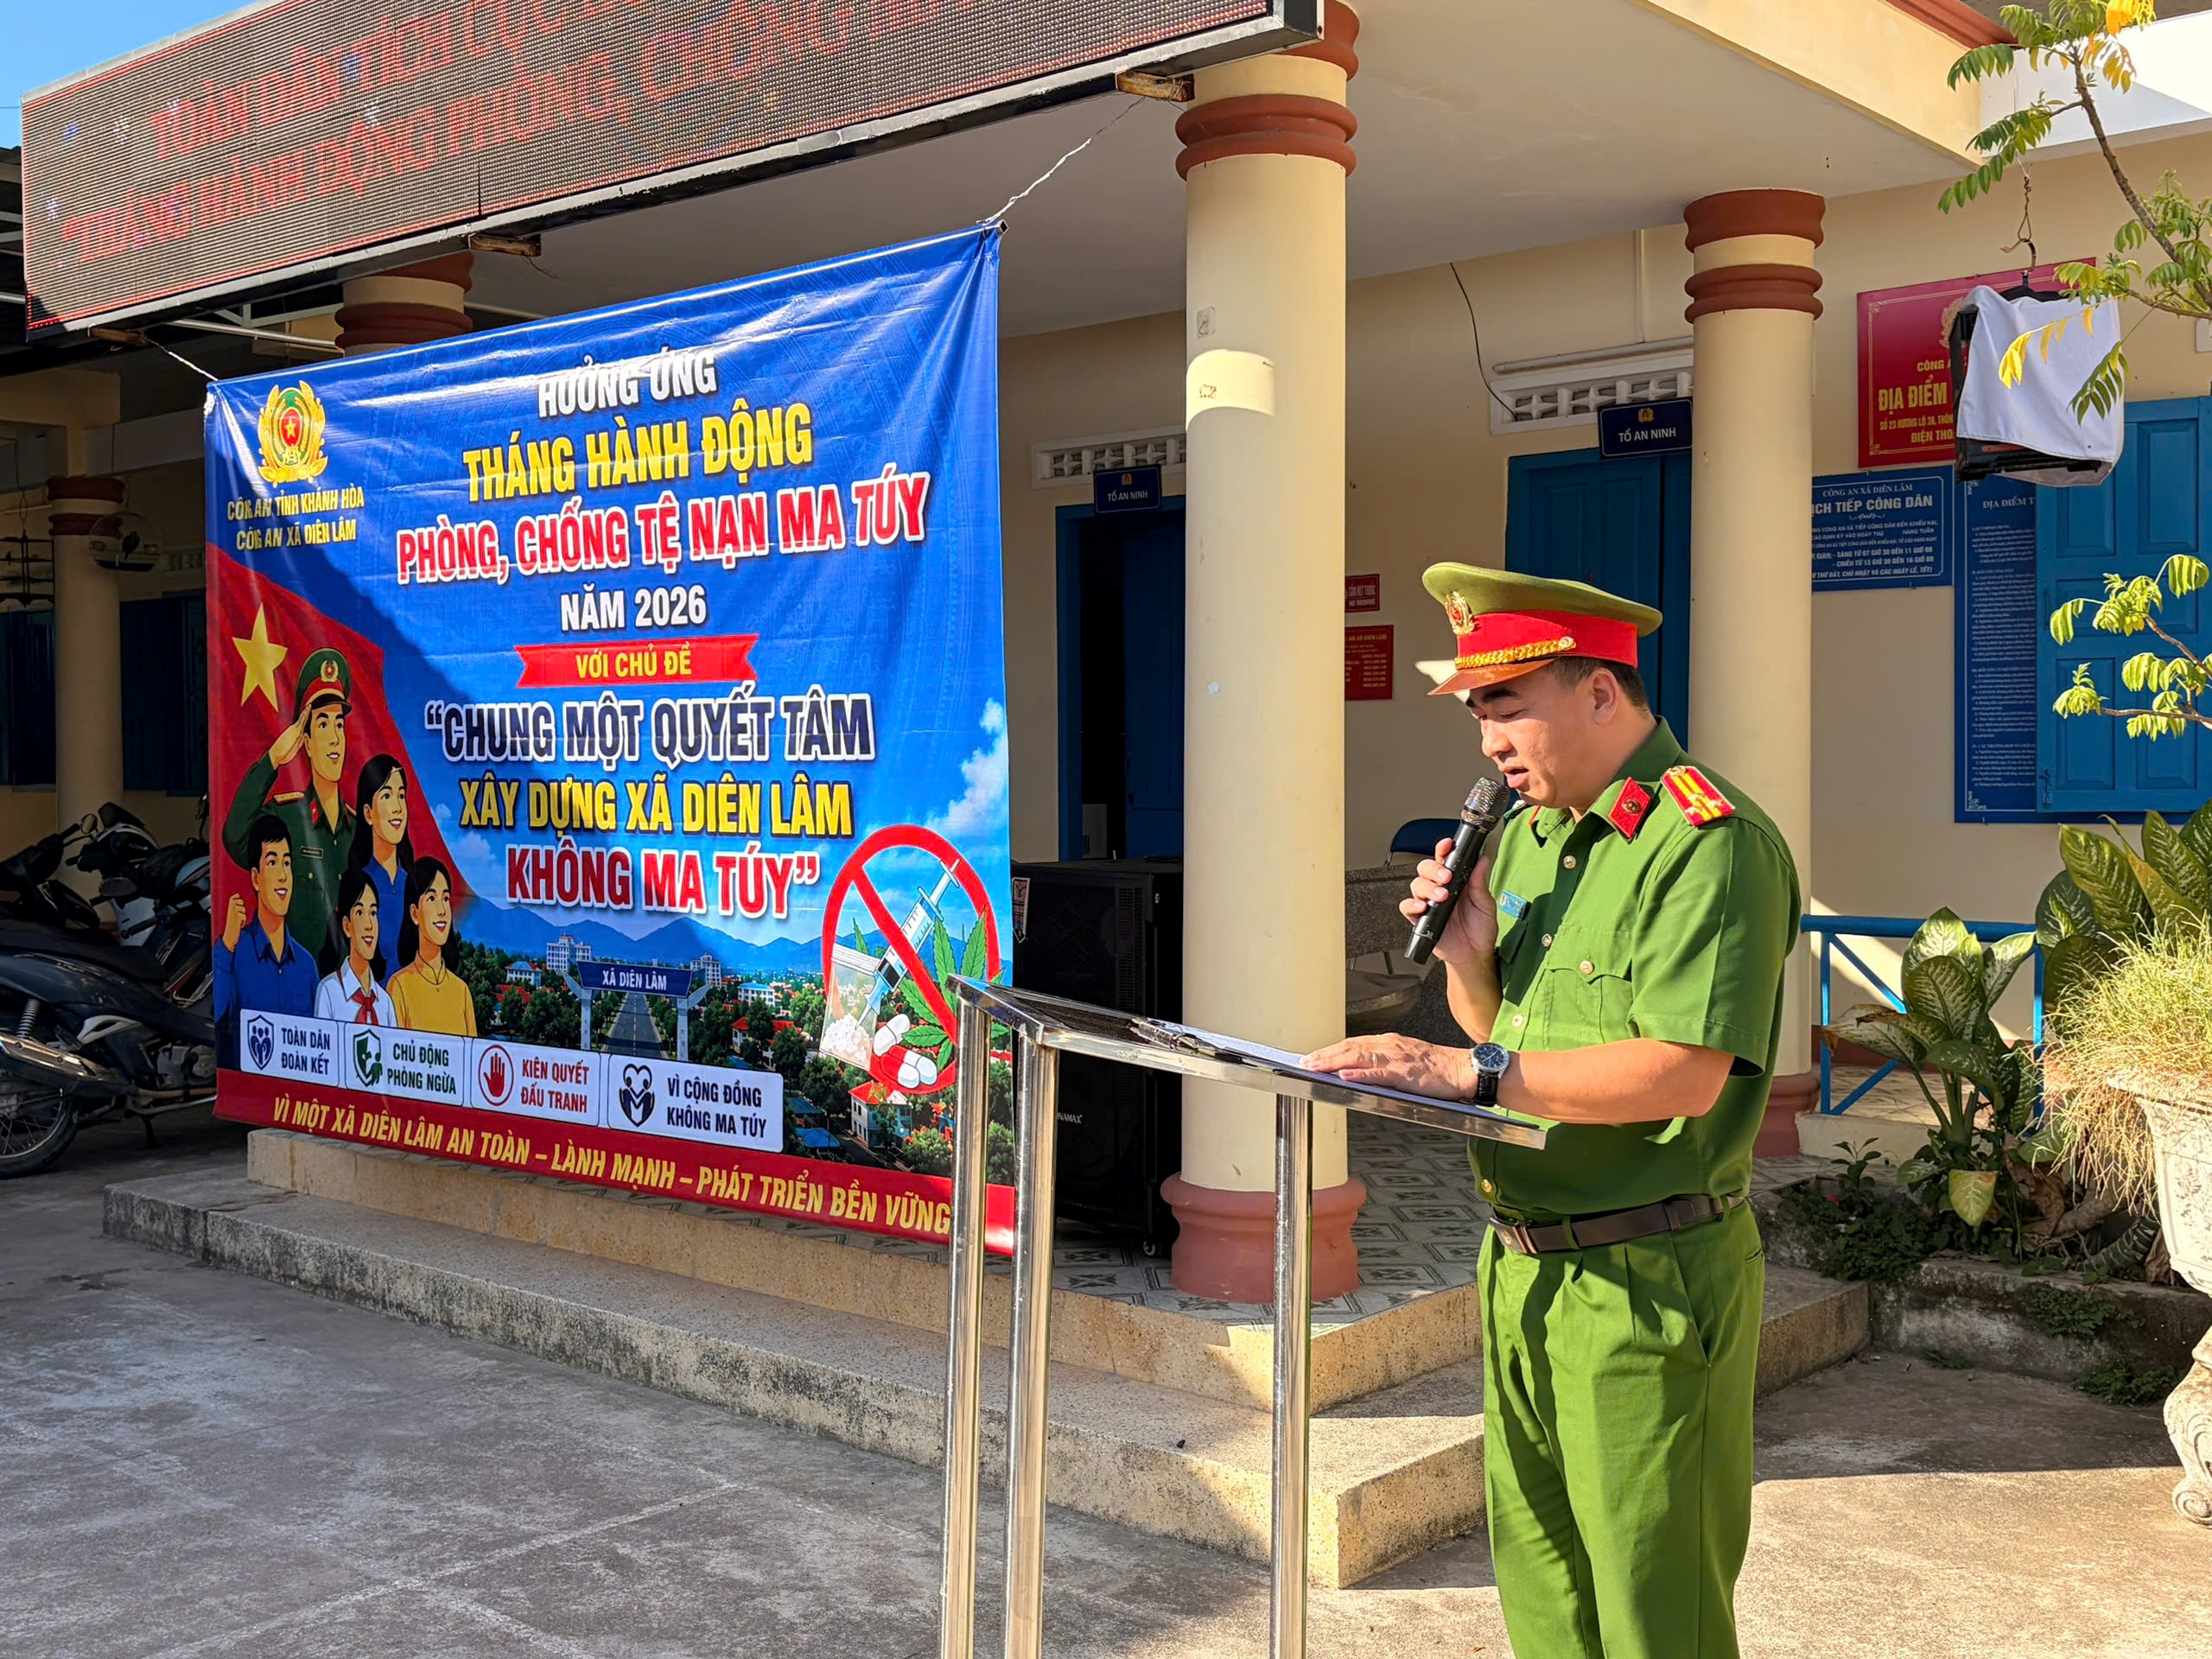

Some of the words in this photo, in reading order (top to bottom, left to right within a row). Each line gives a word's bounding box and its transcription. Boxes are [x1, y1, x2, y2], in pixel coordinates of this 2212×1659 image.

[197, 154, 308, 230] HÀNH
[537, 353, 639, 417] HƯỞNG
[649, 346, 716, 399] ỨNG
[1917, 359, 1944, 372] CÔNG
[1878, 387, 1904, 415] ĐỊA
[1908, 374, 1948, 408] ĐIỂM
[1633, 429, 1649, 442] AN
[1650, 427, 1676, 440] NINH
[1911, 429, 1933, 444] ĐIỆN
[1936, 429, 1955, 441] THO
[463, 430, 575, 503] THÁNG
[586, 416, 690, 487] HÀNH
[702, 400, 812, 484] ĐỘNG
[254, 497, 272, 518] AN
[275, 489, 299, 516] TỈNH
[301, 486, 338, 514] KHÁNH
[340, 483, 365, 509] HÒA
[1118, 492, 1129, 500] AN
[1130, 490, 1148, 499] NINH
[1812, 503, 1832, 517] ỊCH
[1834, 497, 1863, 512] TIẾP
[1866, 496, 1902, 511] CÔNG
[1905, 493, 1933, 508] DÂN
[1822, 488, 1846, 498] CÔNG
[1859, 485, 1872, 494] XÃ
[1872, 484, 1892, 493] DIÊN
[1983, 499, 1999, 510] ĐỊA
[2001, 495, 2026, 507] ĐIỂM
[264, 527, 283, 547] AN
[286, 521, 302, 546] XÃ
[304, 518, 330, 544] DIÊN
[332, 516, 357, 542] LÂM
[397, 516, 510, 585] PHÒNG,
[515, 496, 630, 577] CHỐNG
[637, 491, 680, 573] TỆ
[689, 492, 769, 569] NẠN
[778, 484, 845, 553] MA
[851, 463, 931, 545] TÚY
[561, 584, 625, 631] NĂM
[634, 585, 707, 627] 2026
[575, 648, 609, 678] VỚI
[614, 643, 658, 677] CHỦ
[664, 642, 692, 676] ĐỀ
[563, 691, 644, 771] MỘT
[650, 680, 773, 770] QUYẾT
[780, 684, 876, 761] TÂM
[459, 774, 526, 828] XÂY
[529, 774, 617, 836] DỰNG
[626, 774, 673, 832] XÃ
[683, 774, 761, 835] DIÊN
[771, 774, 853, 836] LÂM
[506, 836, 632, 908] KHÔNG
[641, 848, 708, 915] MA
[601, 966, 617, 988] XÃ
[618, 969, 643, 990] DIÊN
[645, 969, 667, 991] LÂM
[281, 1024, 306, 1048] TOÀN
[308, 1027, 331, 1052] DÂN
[392, 1039, 415, 1064] CHỦ
[416, 1042, 449, 1070] ĐỘNG
[281, 1047, 308, 1073] ĐOÀN
[310, 1049, 329, 1076] KẾT
[521, 1055, 550, 1082] KIÊN
[552, 1058, 589, 1088] QUYẾT
[386, 1063, 423, 1090] PHÒNG
[426, 1070, 457, 1095] NGỪA
[667, 1074, 683, 1100] VÌ
[684, 1078, 721, 1106] CỘNG
[721, 1079, 762, 1109] ĐỒNG
[519, 1082, 545, 1109] ĐẤU
[547, 1090, 588, 1114] TRANH
[666, 1102, 710, 1131] KHÔNG
[715, 1112, 736, 1135] MA
[738, 1110, 767, 1139] TÚY
[273, 1094, 292, 1122] VÌ
[293, 1101, 327, 1131] MỘT
[330, 1103, 356, 1133] XÃ
[359, 1109, 401, 1141] DIÊN
[404, 1114, 444, 1150] LÂM
[446, 1129, 473, 1155] AN
[479, 1126, 531, 1165] TOÀN
[550, 1141, 606, 1179] LÀNH
[612, 1154, 676, 1192] MẠNH
[696, 1161, 753, 1203] PHÁT
[759, 1168, 825, 1214] TRIỂN
[831, 1178, 877, 1224] BỀN
[885, 1192, 950, 1236] VỮNG
